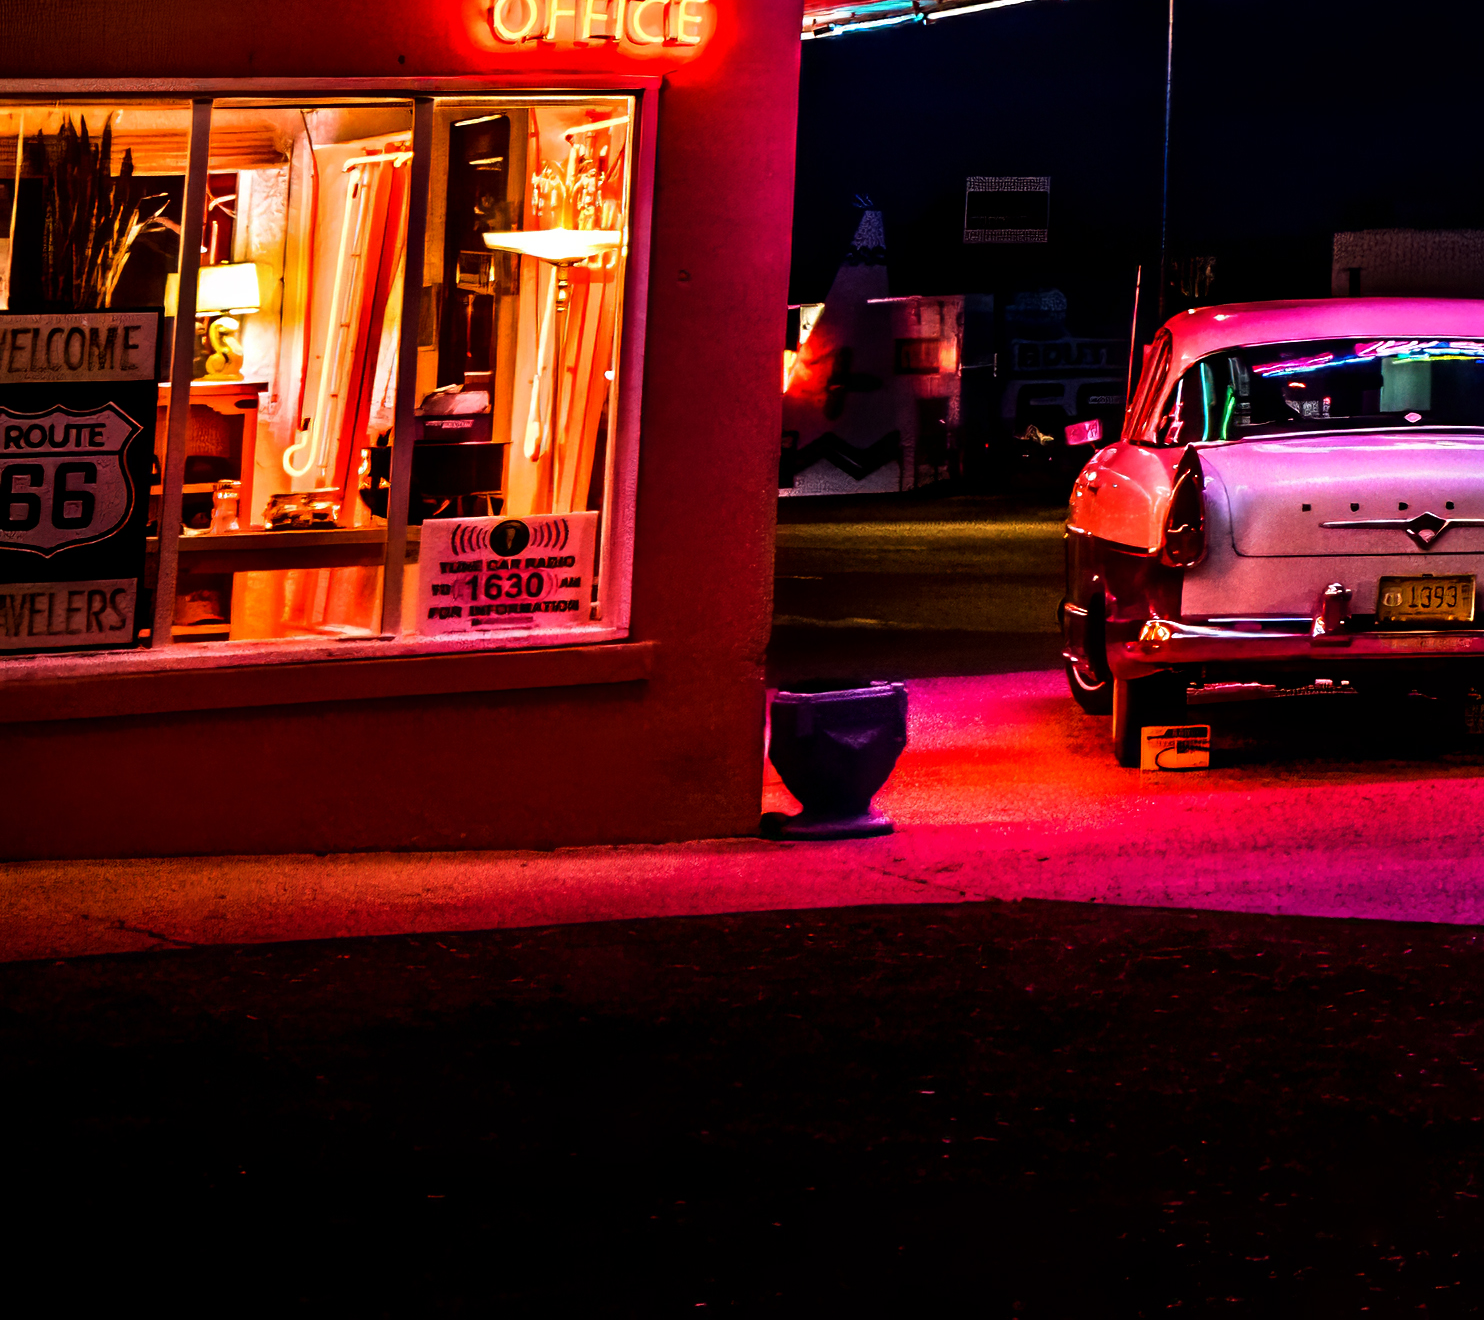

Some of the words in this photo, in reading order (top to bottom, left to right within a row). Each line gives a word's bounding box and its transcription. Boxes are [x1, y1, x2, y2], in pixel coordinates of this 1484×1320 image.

[4, 423, 106, 451] ROUTE
[0, 461, 97, 532] 66
[486, 559, 521, 570] CAR
[524, 555, 576, 569] RADIO
[465, 571, 545, 601] 1630
[558, 577, 581, 589] AM
[1408, 586, 1458, 609] 1393
[427, 606, 463, 620] FOR
[468, 599, 580, 617] INFORMATION
